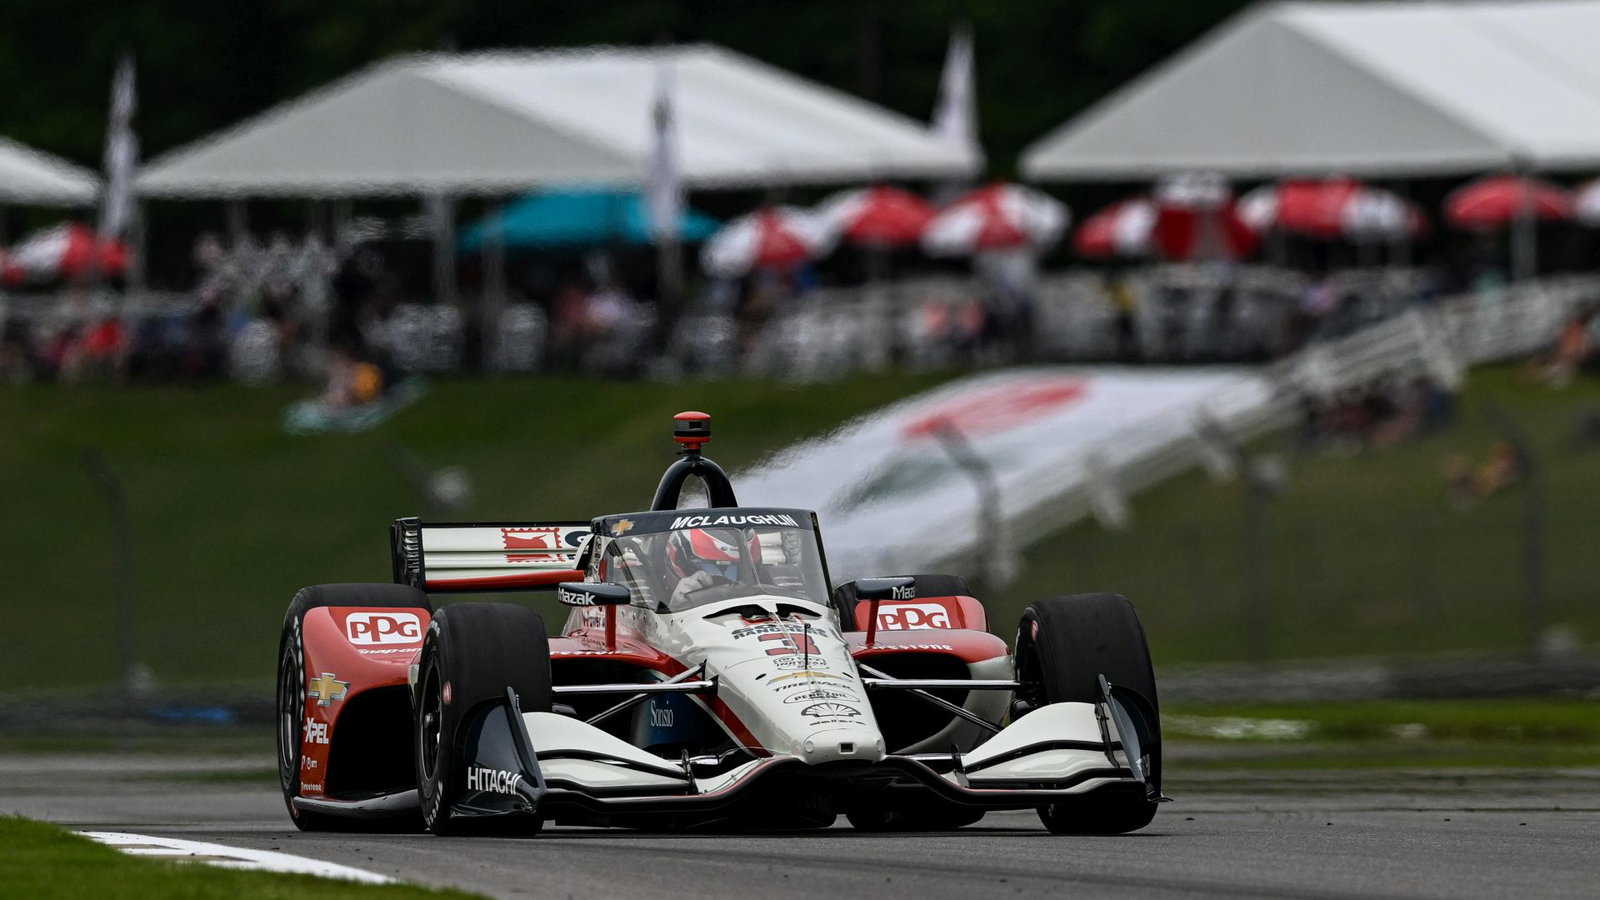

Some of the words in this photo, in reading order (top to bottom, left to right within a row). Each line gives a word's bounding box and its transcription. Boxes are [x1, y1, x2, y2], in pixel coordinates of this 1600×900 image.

[670, 514, 799, 530] MCLAUGHLIN
[558, 587, 596, 605] Mazak
[350, 615, 419, 642] PPG
[879, 607, 949, 630] PPG
[757, 633, 822, 655] 3
[650, 699, 674, 727] Sonsio
[303, 717, 330, 745] XPEL
[467, 766, 521, 795] HITACHI
